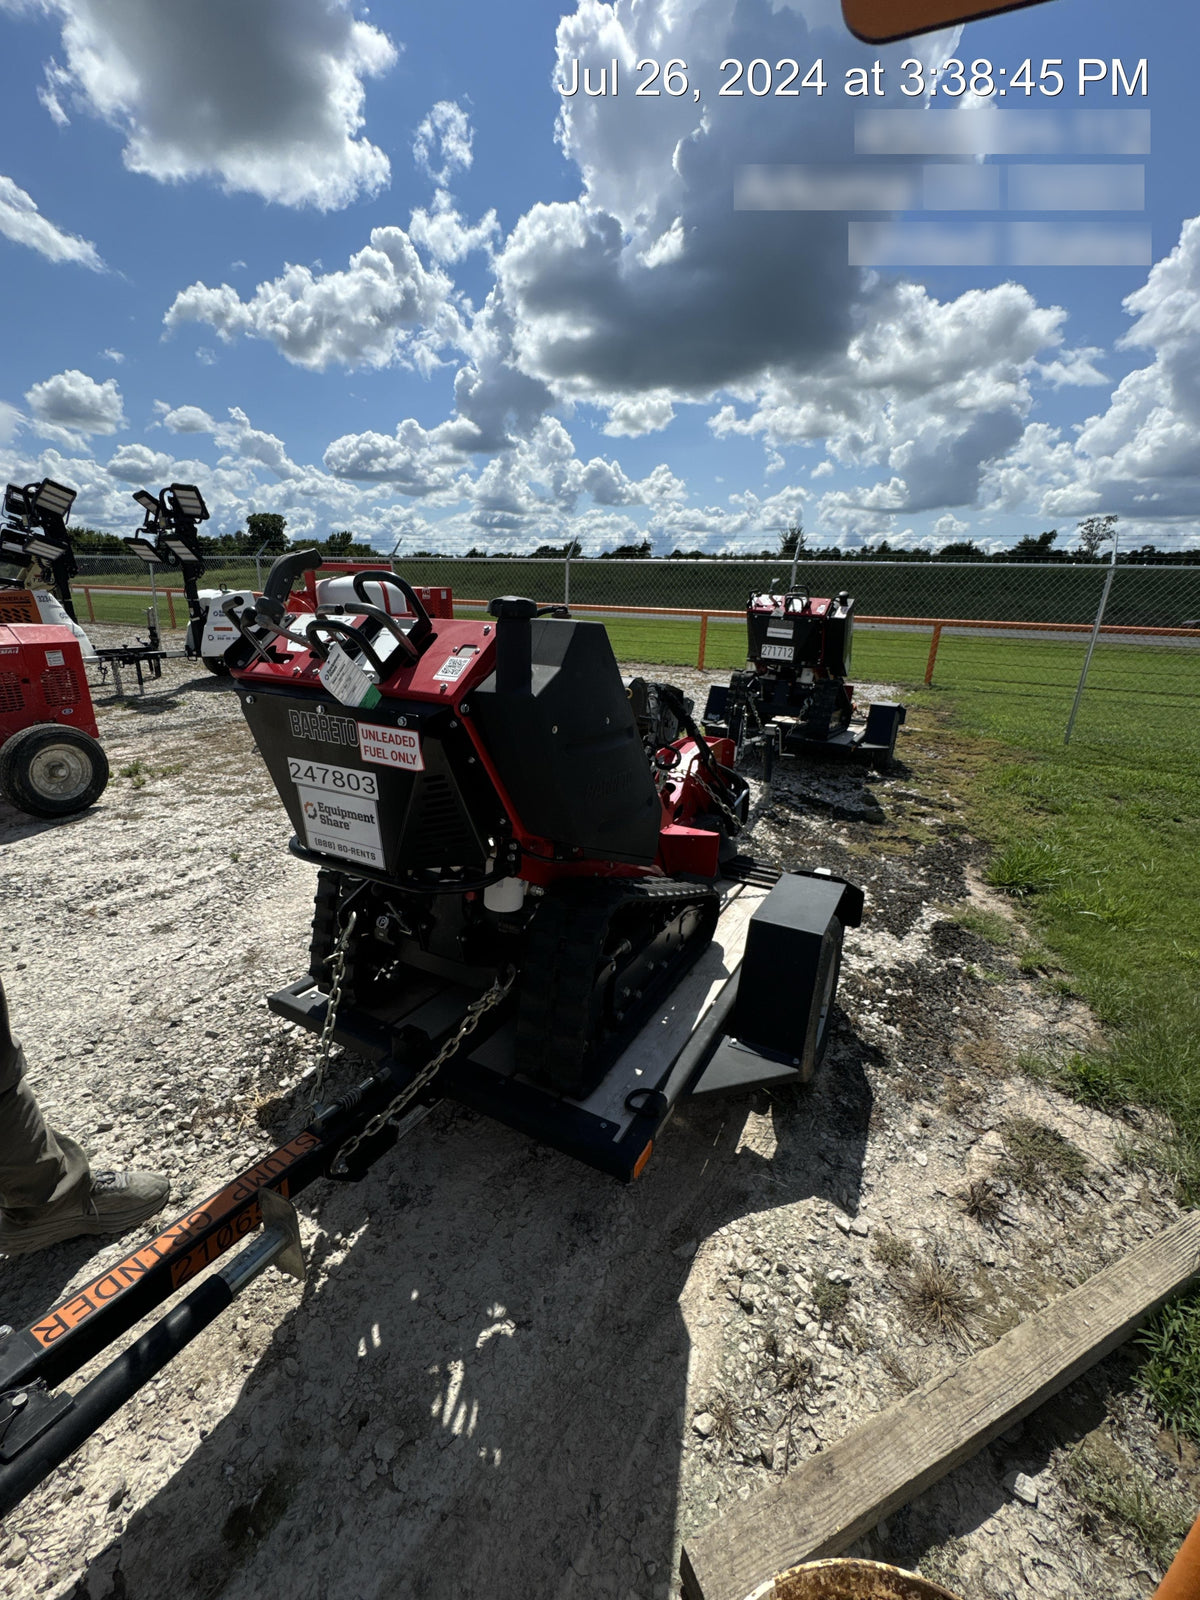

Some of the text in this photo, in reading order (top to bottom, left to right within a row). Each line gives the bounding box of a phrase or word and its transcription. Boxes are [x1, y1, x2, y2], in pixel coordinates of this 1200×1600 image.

[761, 645, 793, 658] 271712
[289, 709, 359, 747] BARRETO
[361, 728, 416, 748] UNLEADED
[363, 745, 417, 765] FUEL ONLY
[289, 762, 376, 794] 247803
[317, 802, 376, 824] Equipment
[319, 814, 351, 830] Share
[31, 1134, 317, 1343] STUMP GRINDER
